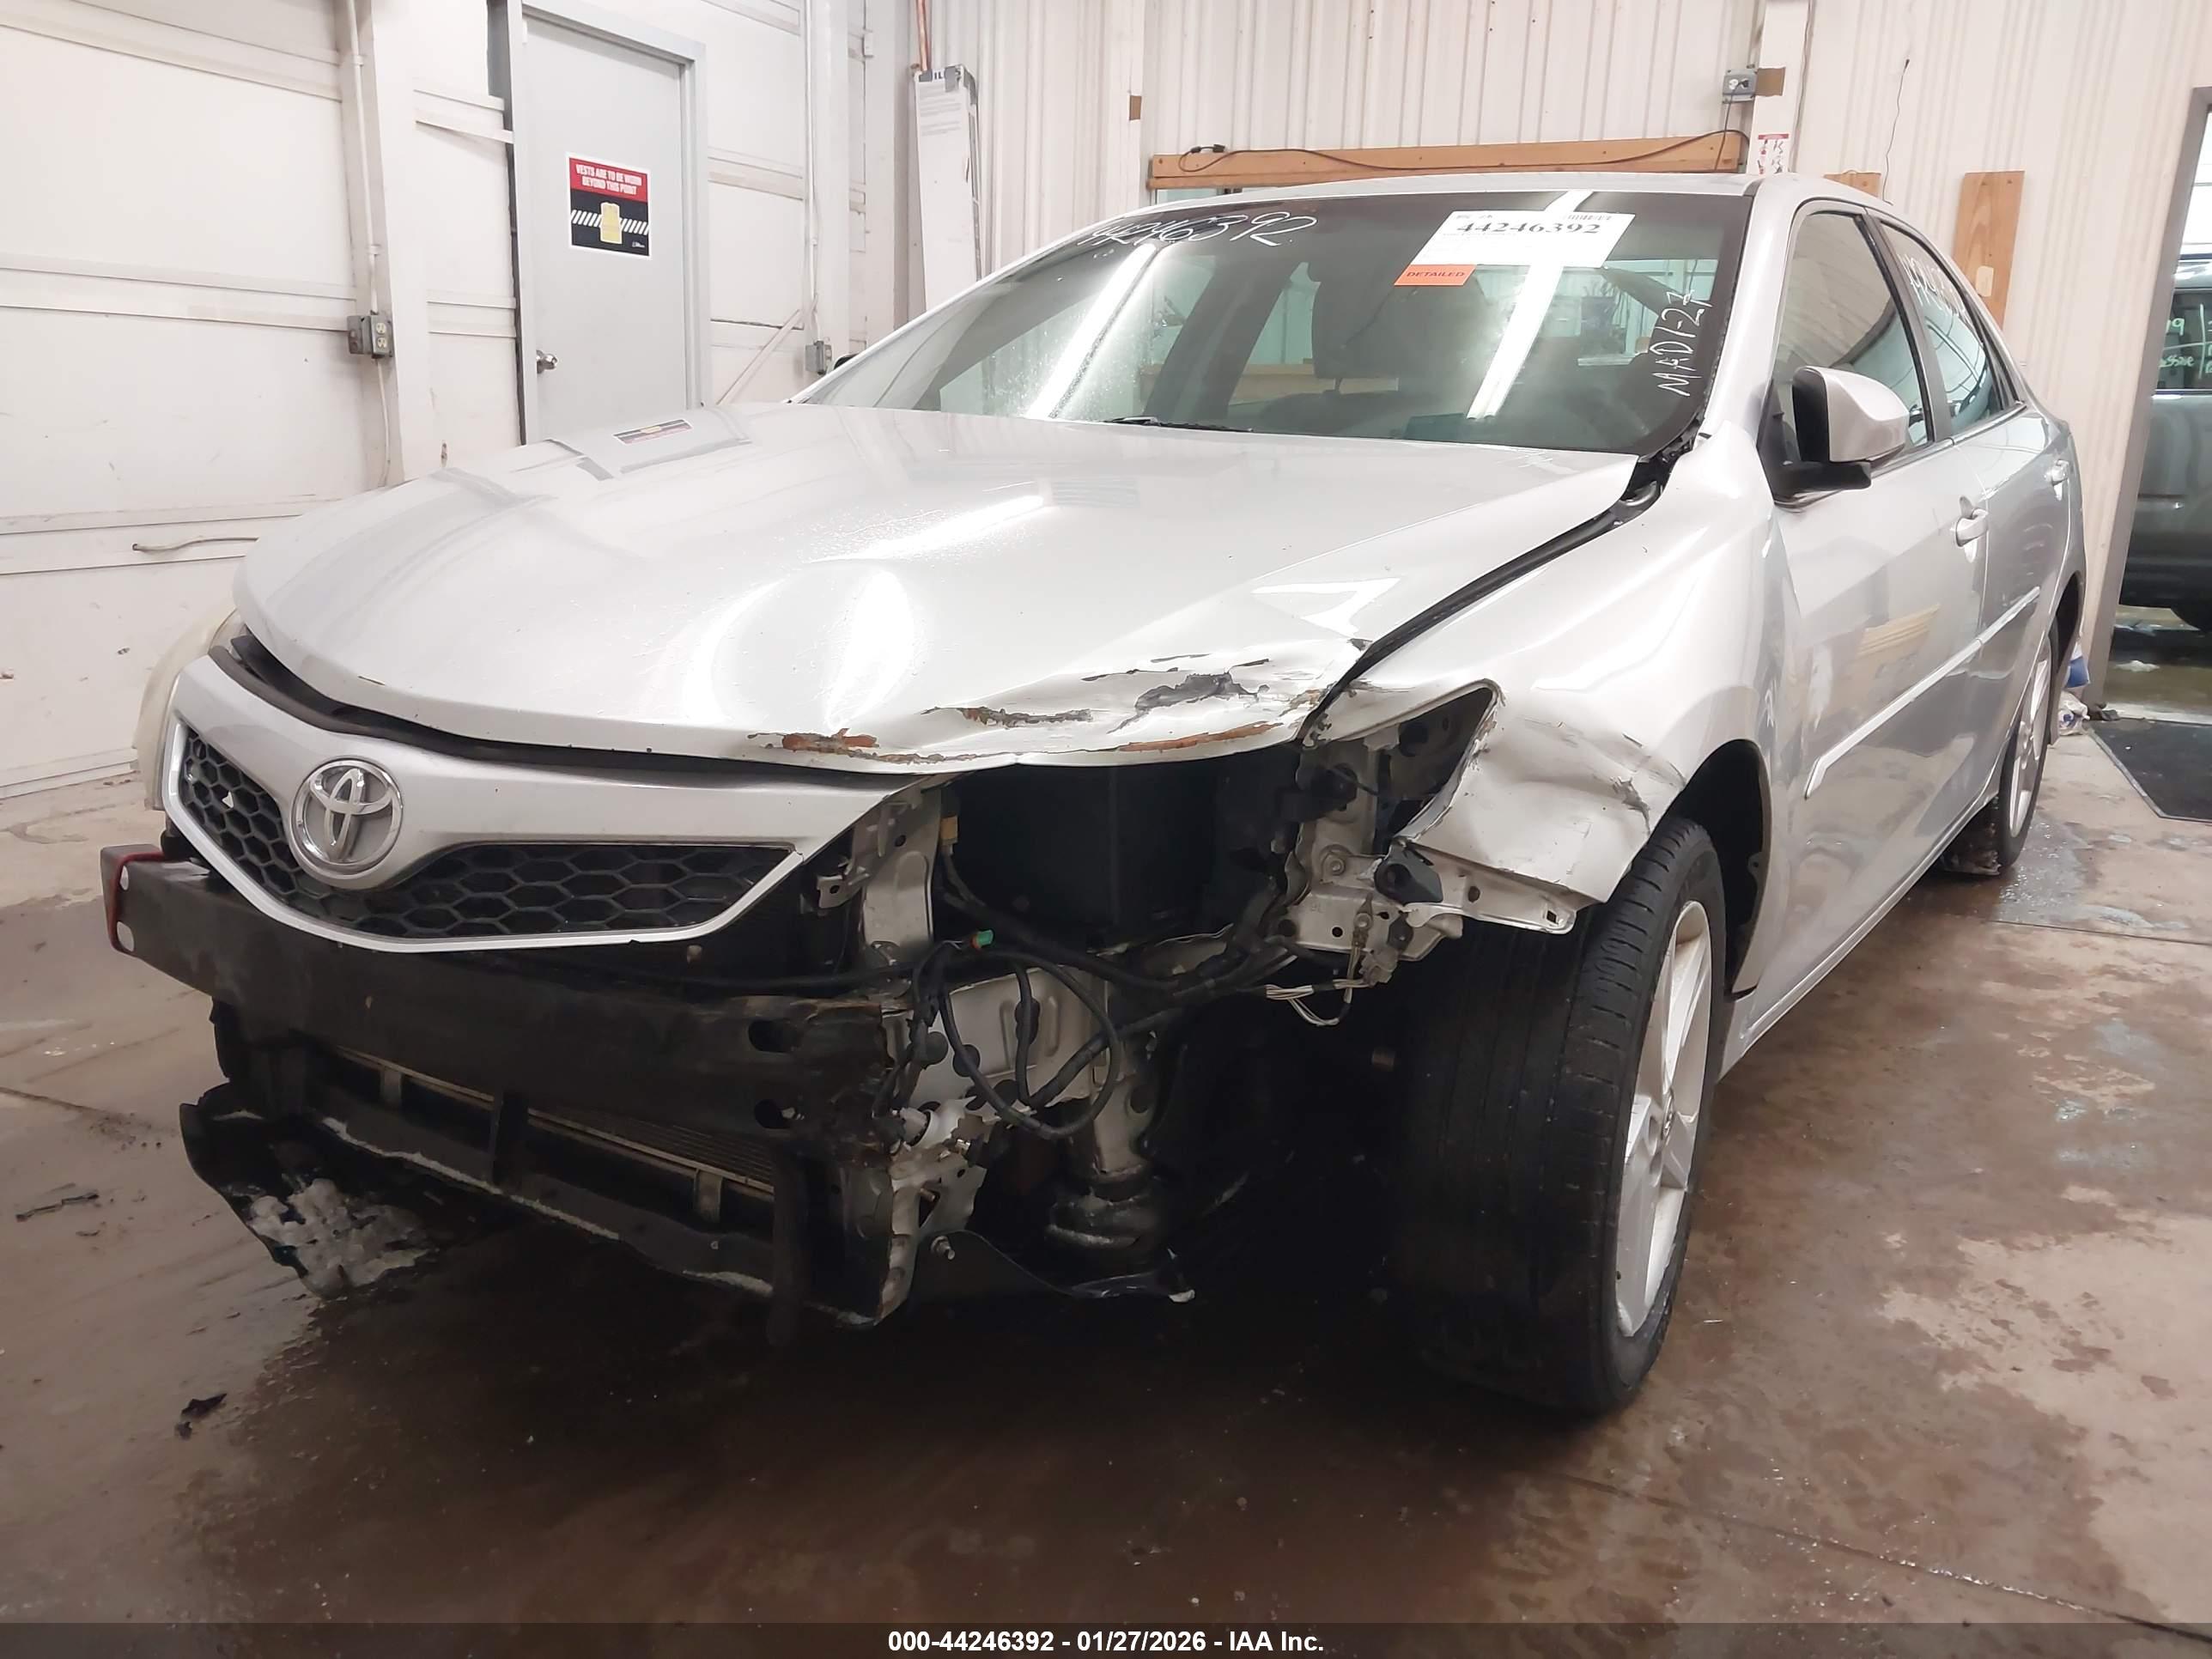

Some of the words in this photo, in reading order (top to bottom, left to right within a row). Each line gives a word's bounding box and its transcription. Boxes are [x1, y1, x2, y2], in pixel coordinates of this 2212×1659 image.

[576, 164, 594, 176] VESTS
[596, 168, 607, 179] ARE
[608, 171, 615, 180] TO
[617, 172, 624, 182] BE
[582, 176, 605, 189] BEYOND
[606, 180, 619, 192] THIS
[620, 185, 636, 195] POINT
[1456, 222, 1601, 234] 44246392
